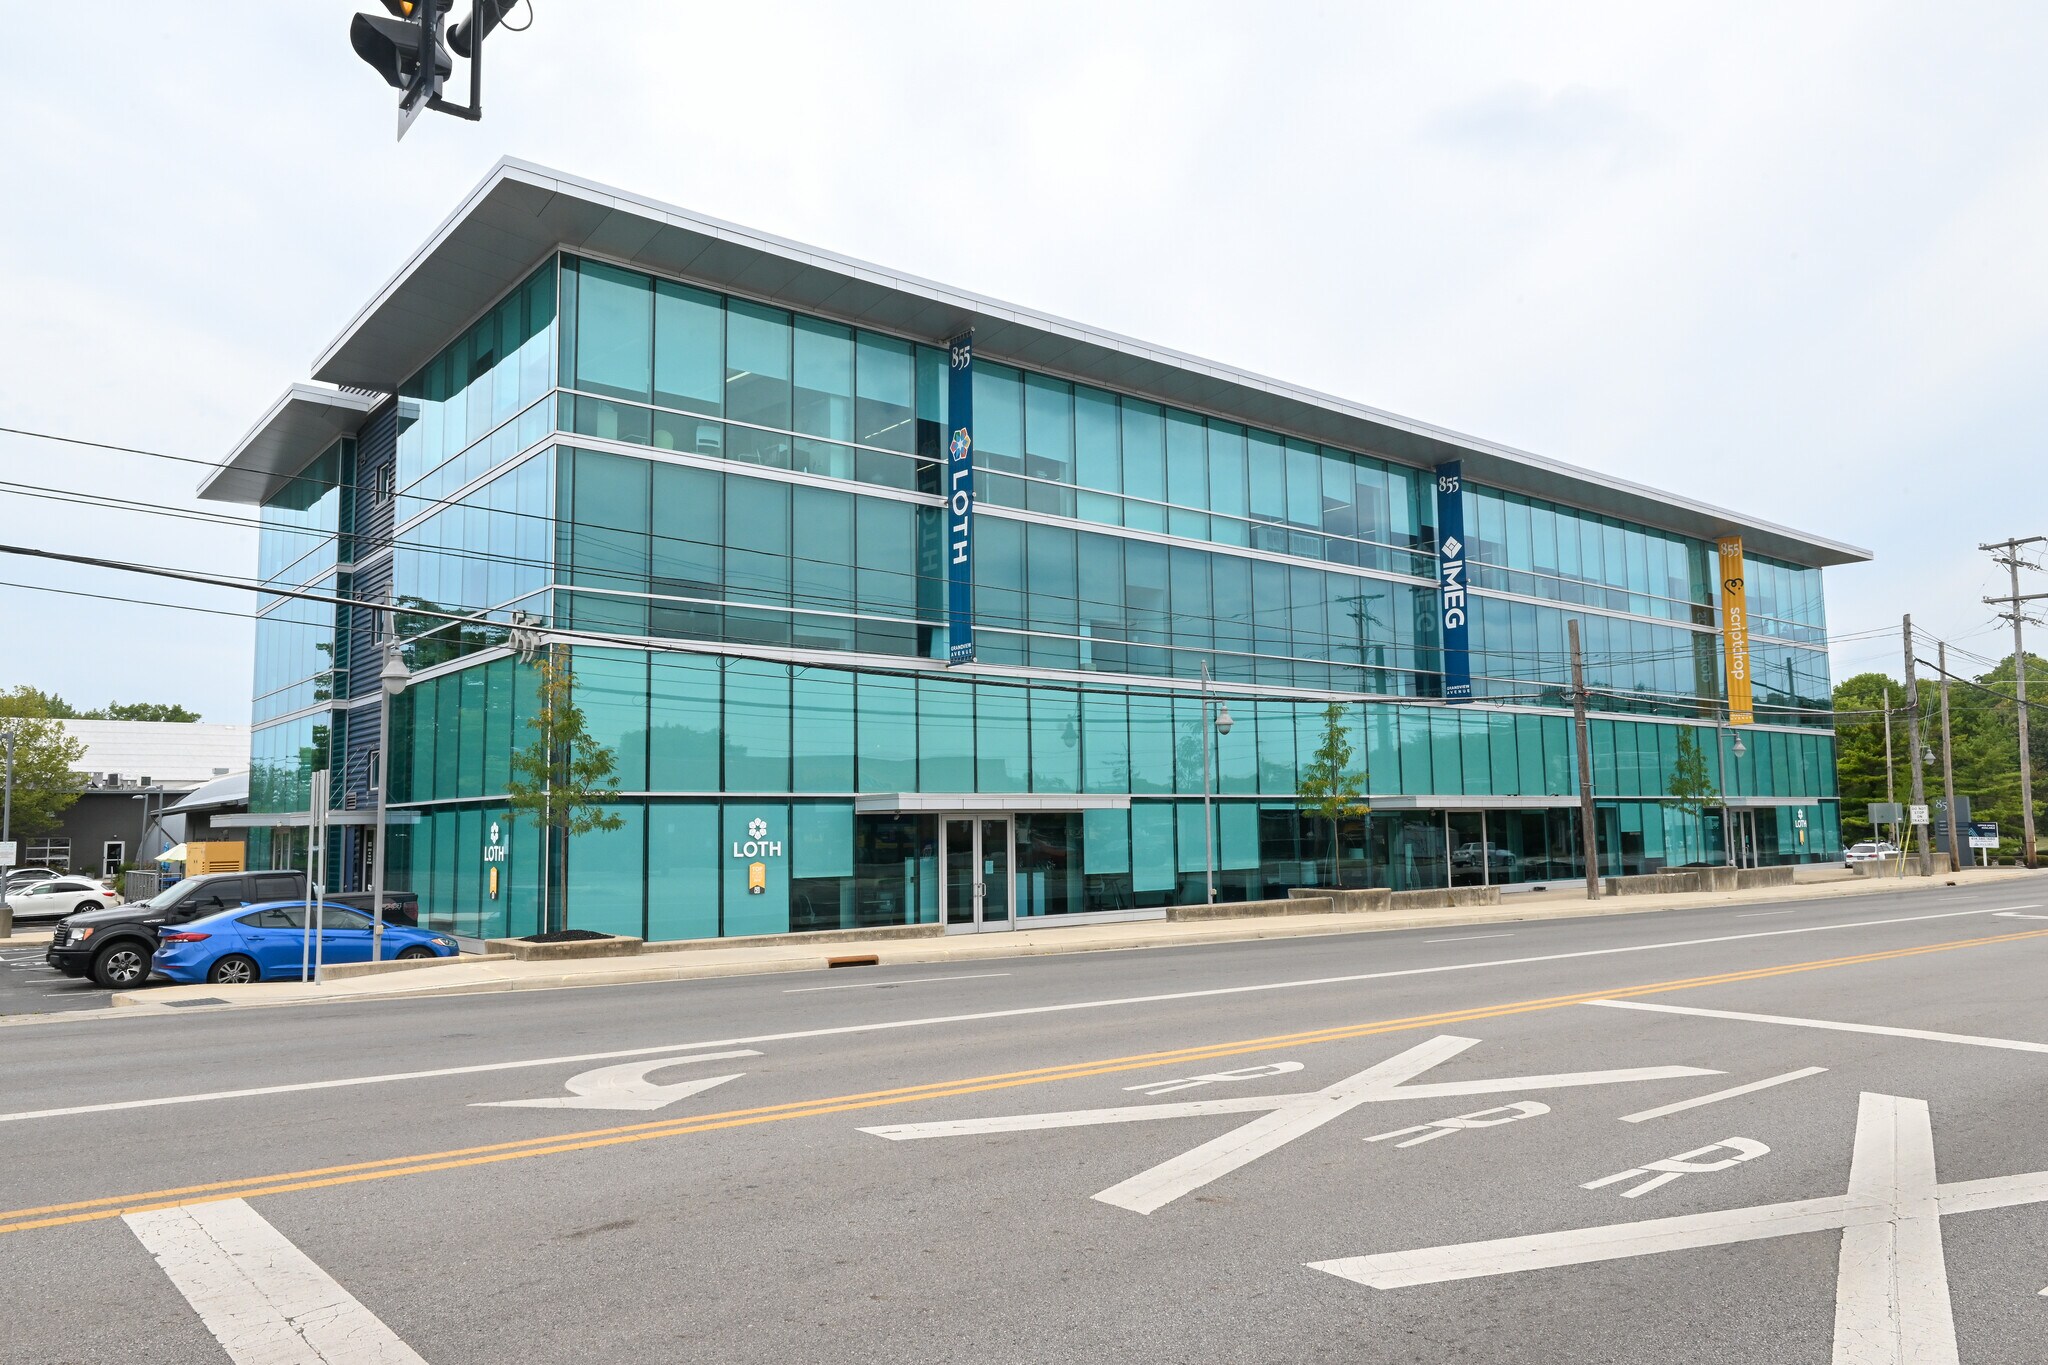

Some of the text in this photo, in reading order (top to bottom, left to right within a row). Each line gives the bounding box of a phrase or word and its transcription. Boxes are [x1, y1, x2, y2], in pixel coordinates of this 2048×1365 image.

[952, 346, 970, 370] 855
[1439, 476, 1459, 494] 855
[953, 469, 969, 565] LOTH
[1721, 543, 1740, 558] 855
[1443, 560, 1465, 630] IMEG
[1728, 607, 1748, 680] scriptdrop
[1795, 820, 1807, 828] LOTH
[484, 846, 504, 862] LOTH
[734, 841, 781, 858] LOTH
